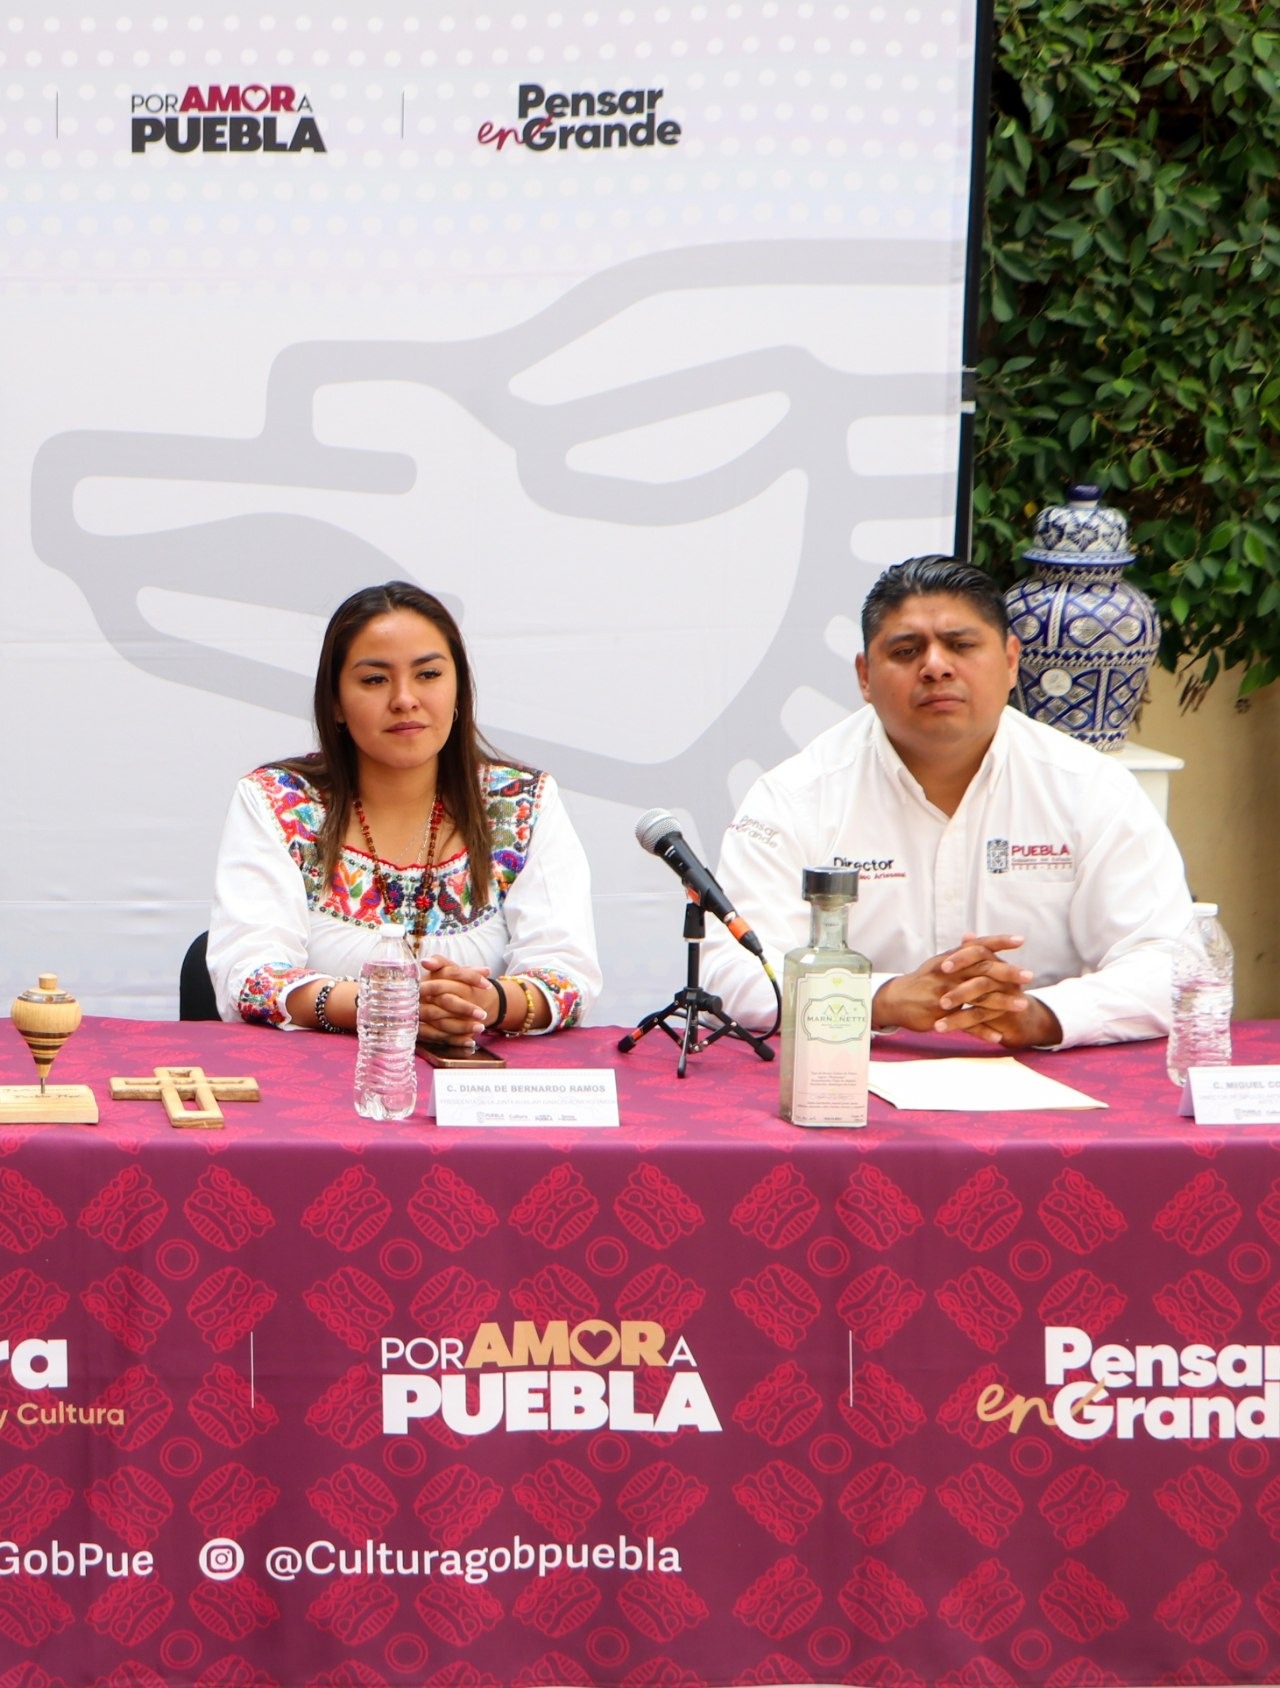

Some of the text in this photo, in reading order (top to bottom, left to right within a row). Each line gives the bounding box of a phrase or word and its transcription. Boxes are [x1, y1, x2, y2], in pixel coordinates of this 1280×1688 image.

[131, 84, 314, 113] POR AMOR A
[517, 83, 665, 118] Pensar
[131, 114, 328, 153] PUEBLA
[523, 113, 682, 151] Grande
[833, 856, 894, 871] Director
[1011, 843, 1071, 857] PUEBLA
[447, 1084, 606, 1093] C. DIANA DE BERNARDO RAMOS
[1226, 1081, 1265, 1089] MIGUEL
[381, 1319, 698, 1370] POR AMOR A
[17, 1401, 126, 1427] Cultura
[381, 1370, 723, 1436] PUEBLA
[1053, 1381, 1280, 1440] Grand
[264, 1535, 683, 1585] @Culturagobpuebla
